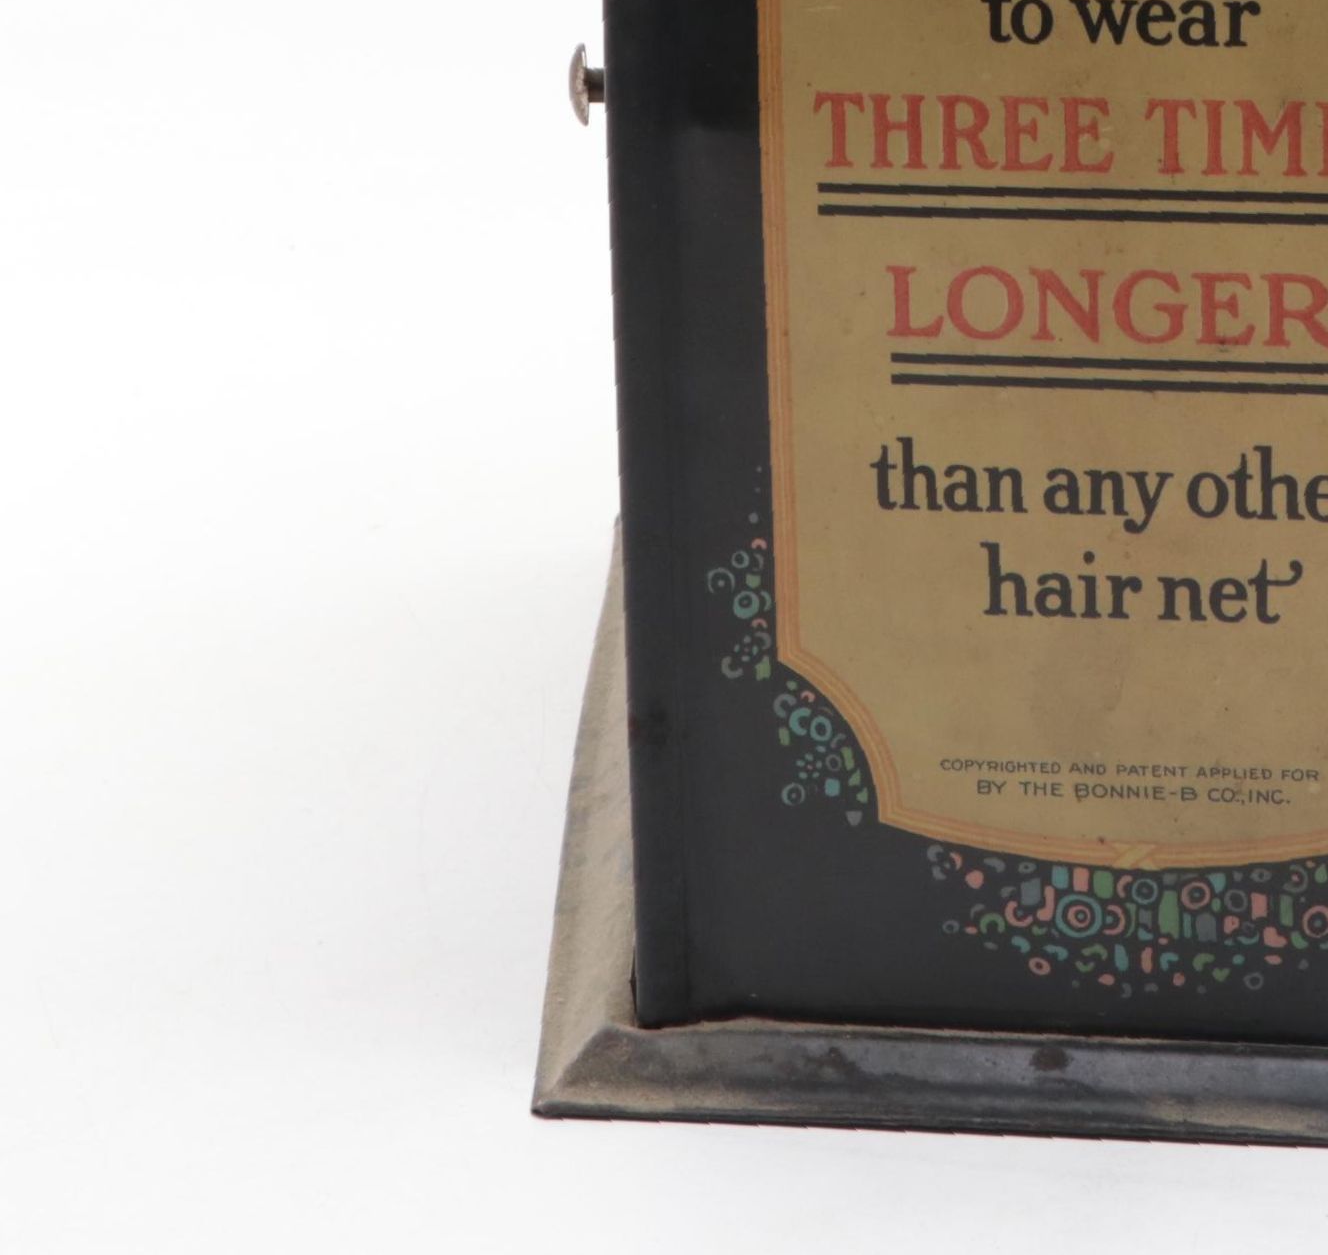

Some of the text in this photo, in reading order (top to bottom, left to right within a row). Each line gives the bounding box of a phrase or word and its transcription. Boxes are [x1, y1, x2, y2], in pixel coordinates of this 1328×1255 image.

[813, 92, 1115, 173] THREE
[869, 437, 1027, 513] than
[1043, 466, 1174, 533] any
[980, 542, 1142, 619] hair
[940, 758, 1320, 783] COPYRIGHTED AND PATENT APPLIED FOR
[977, 779, 1006, 795] BY
[1018, 781, 1064, 797] THE
[1075, 784, 1199, 802] BONNIE-B
